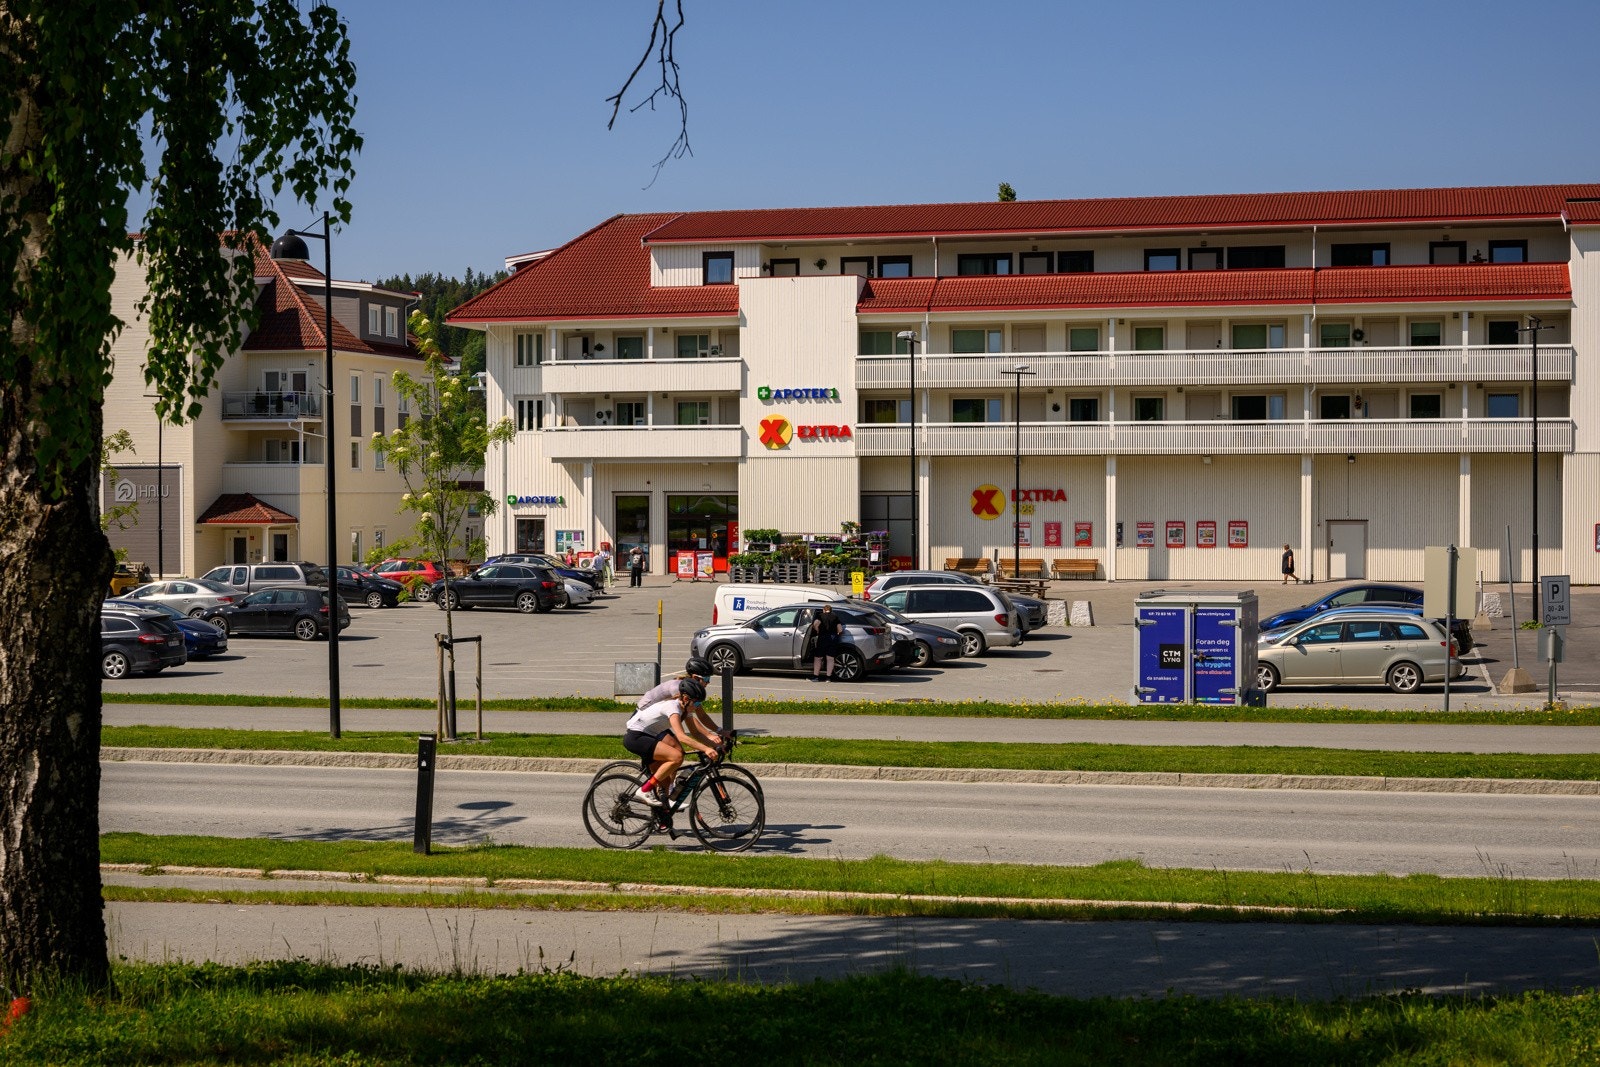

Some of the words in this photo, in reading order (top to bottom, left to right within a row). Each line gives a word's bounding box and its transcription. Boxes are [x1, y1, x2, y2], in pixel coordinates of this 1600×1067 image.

[773, 388, 828, 399] APOTEK
[830, 387, 838, 398] 1
[797, 425, 852, 438] EXTRA
[518, 496, 557, 504] APOTEK
[559, 495, 564, 504] 1
[1011, 489, 1067, 502] EXTRA
[1552, 584, 1560, 600] P
